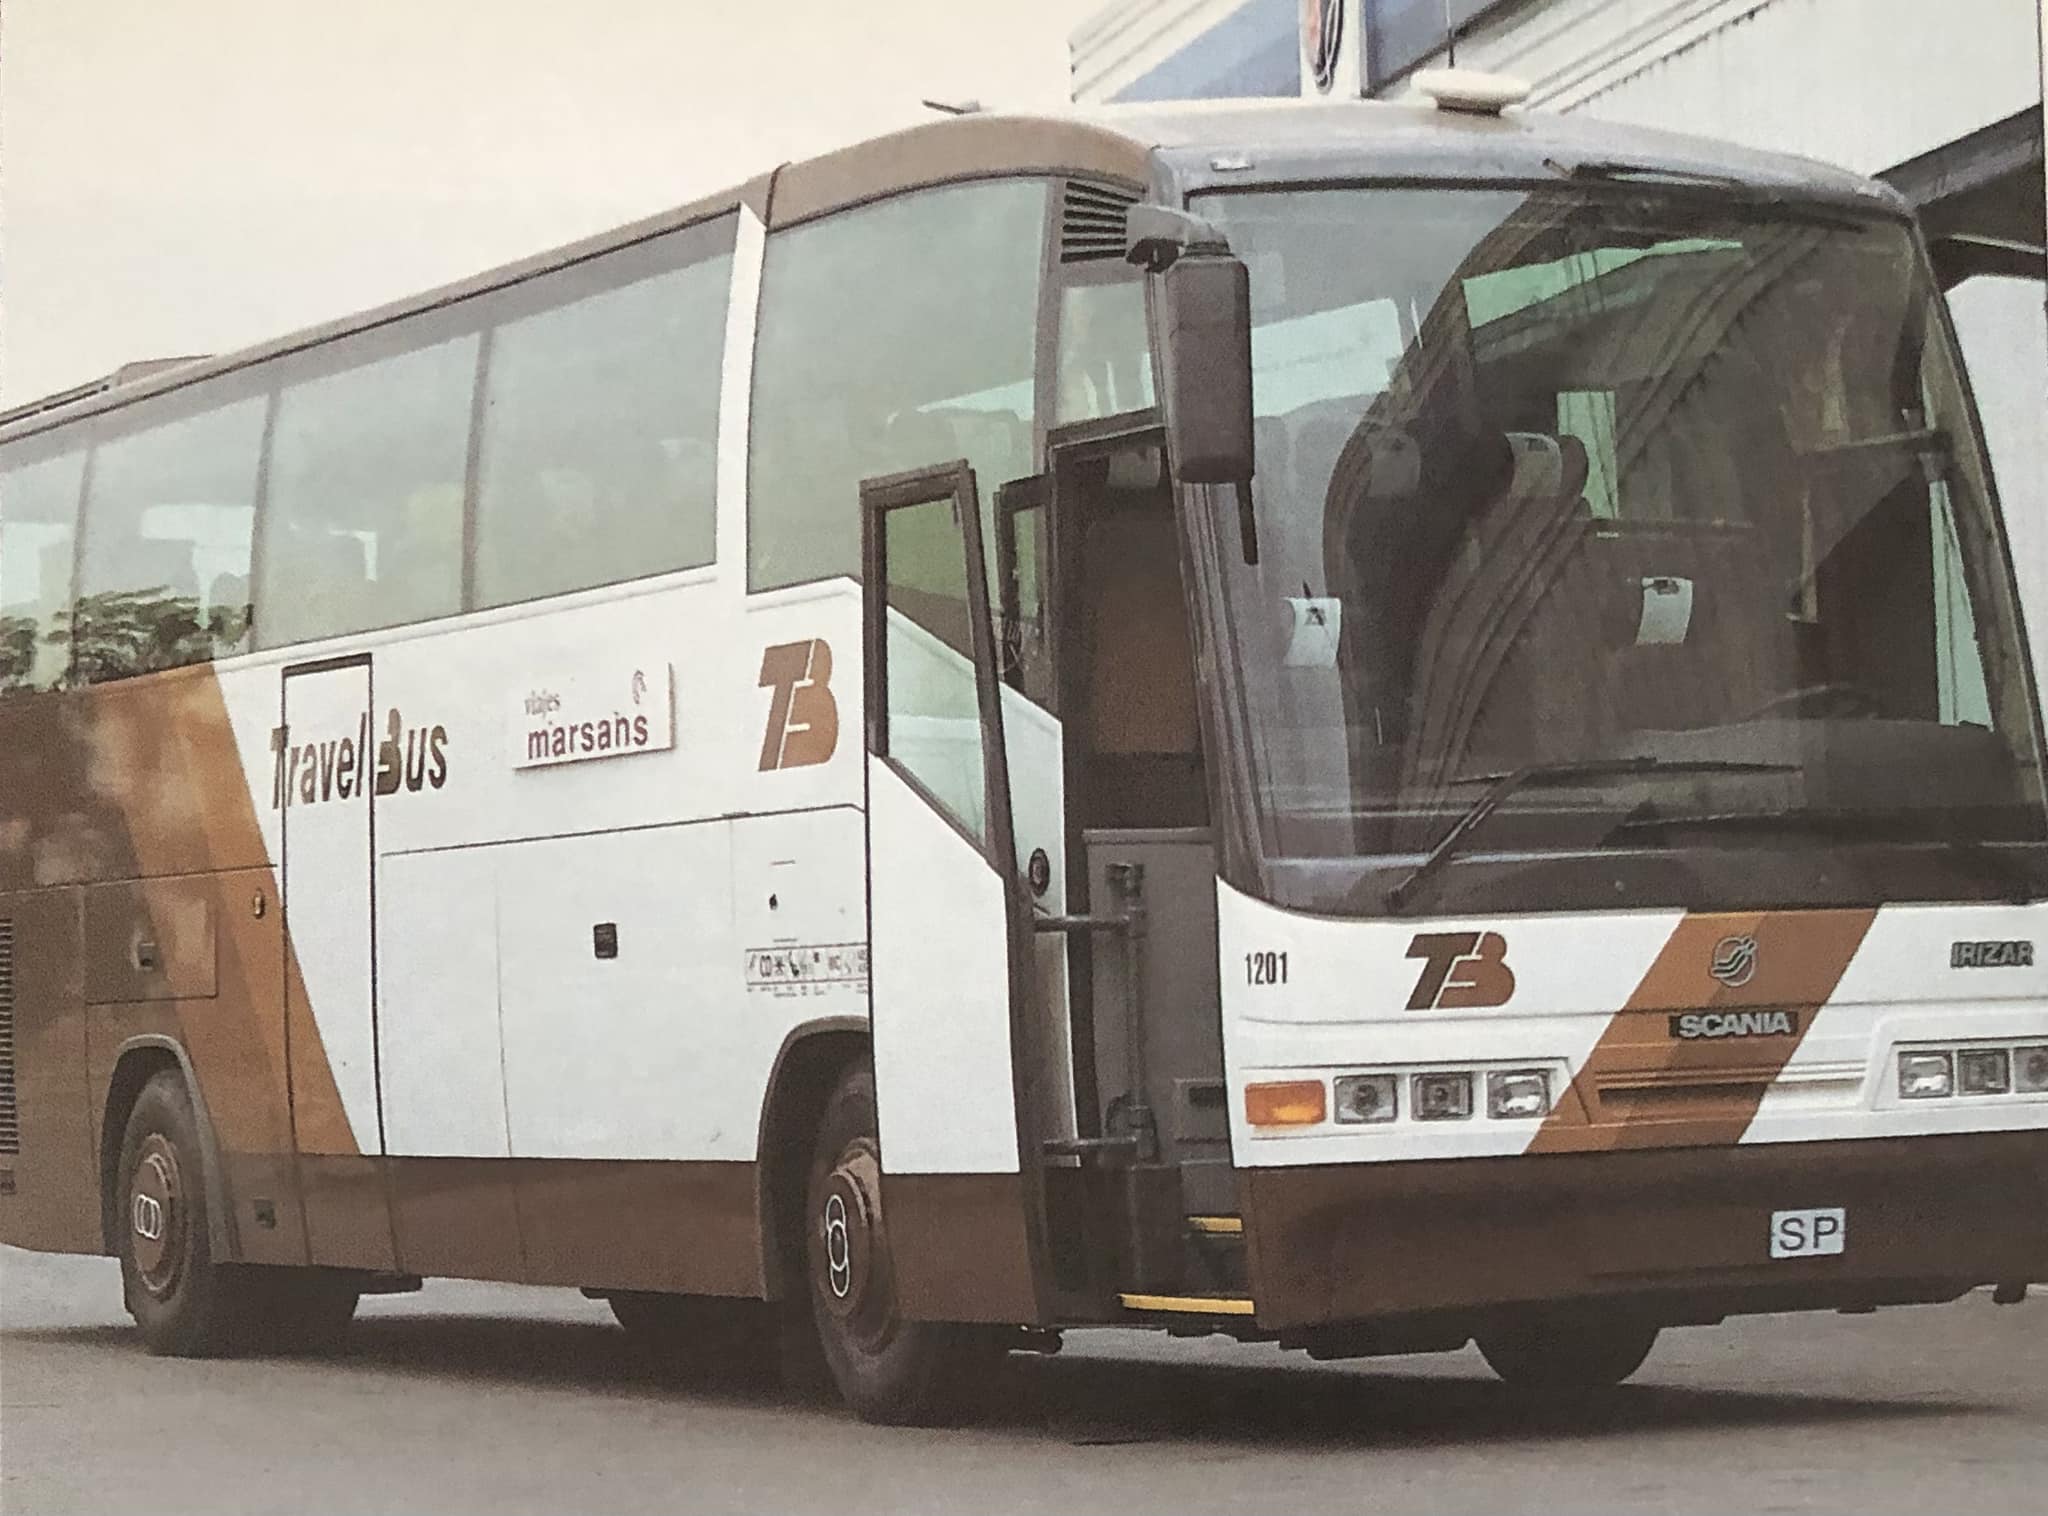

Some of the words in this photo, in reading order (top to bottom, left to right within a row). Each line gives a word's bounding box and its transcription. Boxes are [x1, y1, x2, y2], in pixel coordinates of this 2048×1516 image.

[758, 638, 839, 772] TB
[528, 714, 649, 760] marsans
[1245, 952, 1288, 985] 1201
[1404, 931, 1516, 1011] TB
[1951, 941, 2034, 968] IRIZAR
[1678, 1011, 1791, 1038] SCANIA
[1779, 1216, 1840, 1251] SP
